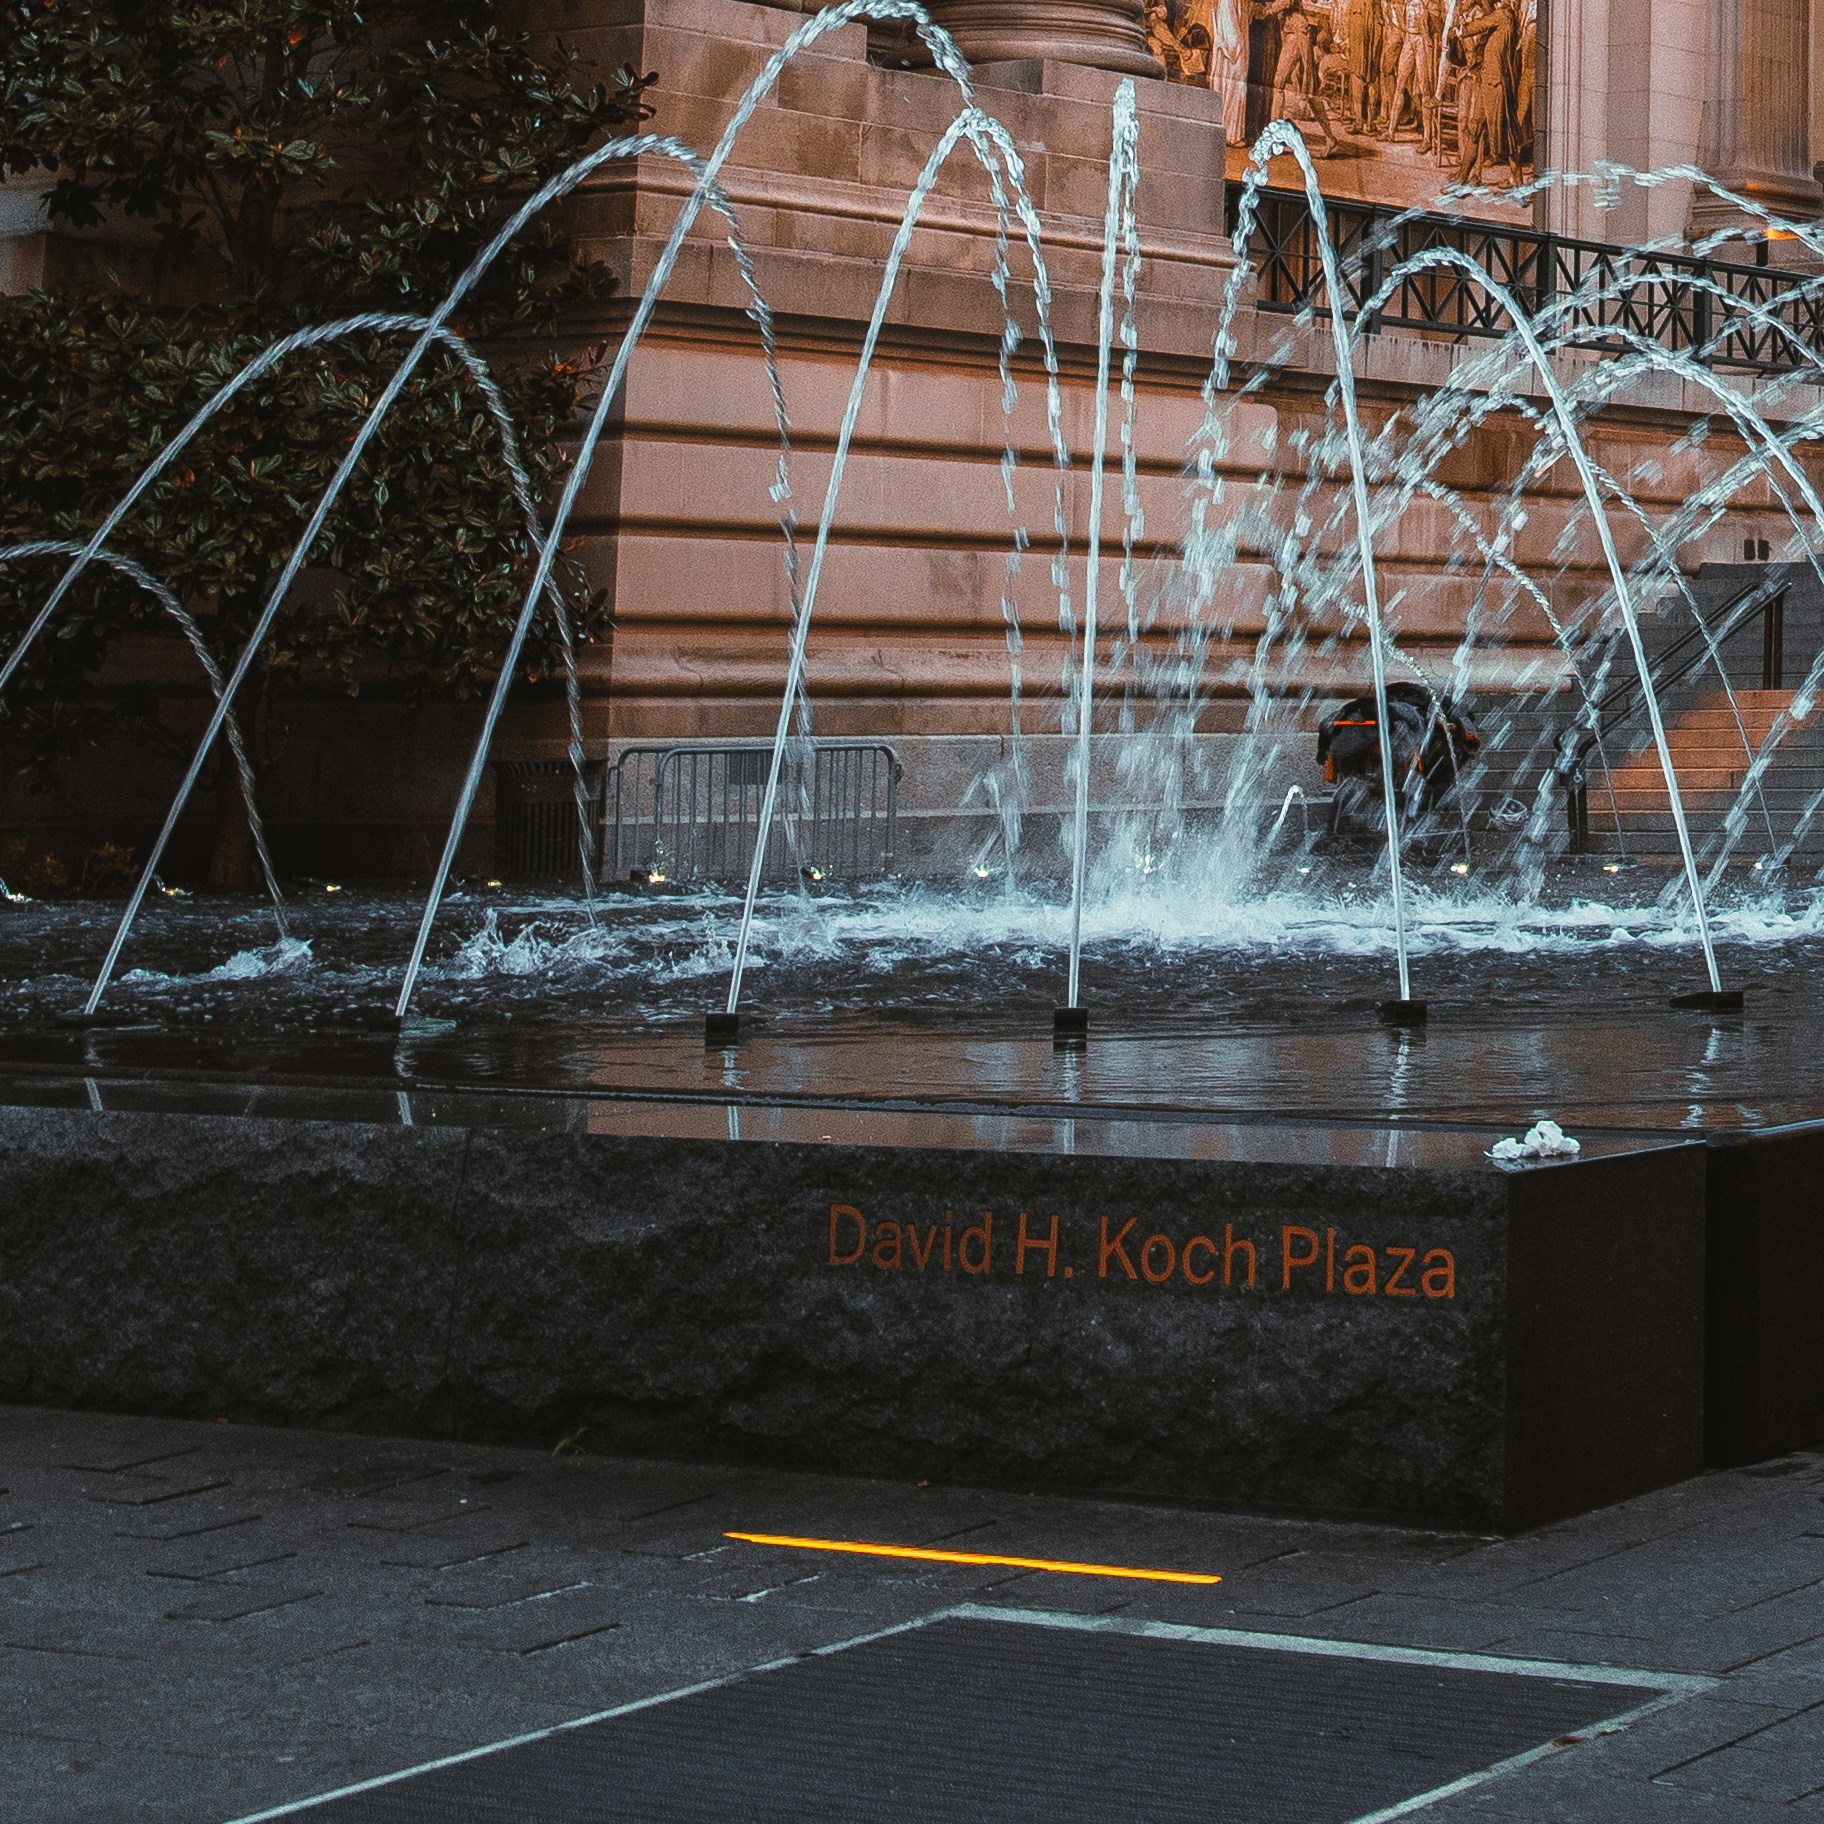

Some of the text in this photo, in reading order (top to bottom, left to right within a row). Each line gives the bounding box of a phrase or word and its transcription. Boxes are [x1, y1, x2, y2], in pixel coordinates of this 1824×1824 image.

[830, 1204, 1455, 1298] David H. Koch Plaza
